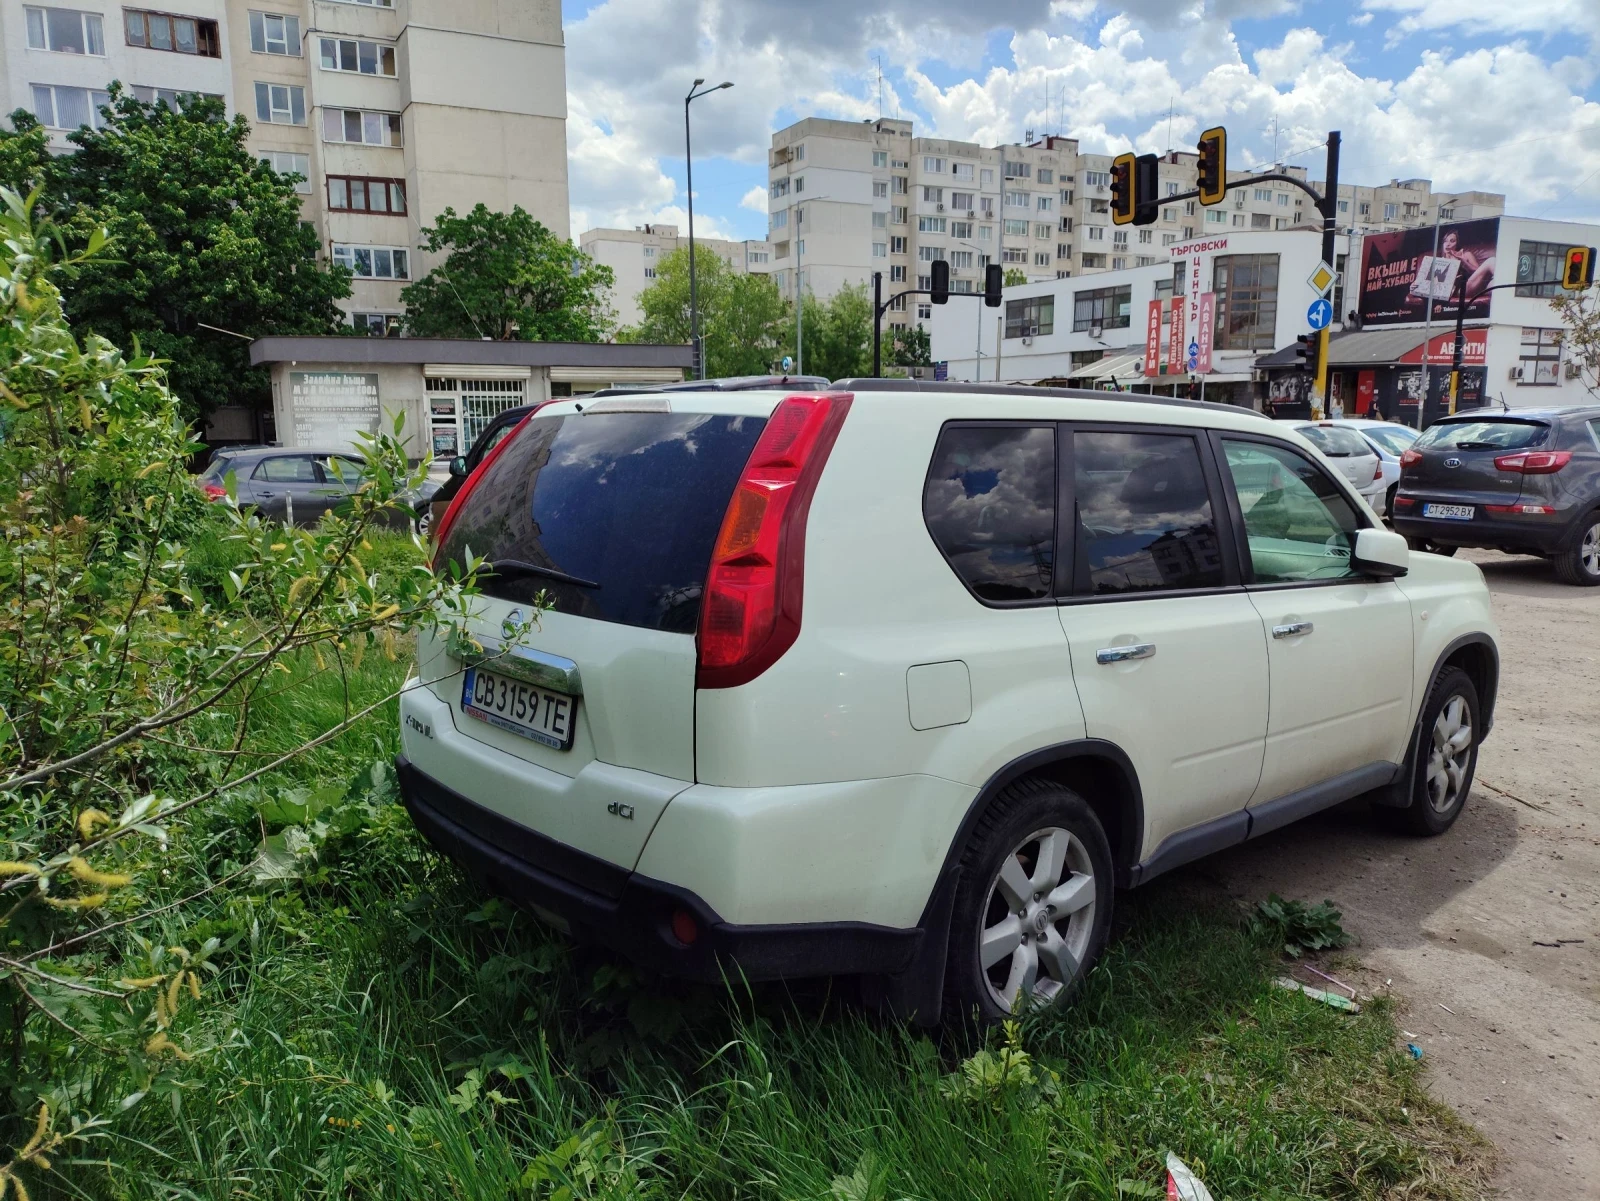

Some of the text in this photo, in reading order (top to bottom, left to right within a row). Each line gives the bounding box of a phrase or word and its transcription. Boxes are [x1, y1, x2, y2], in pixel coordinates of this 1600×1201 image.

[1170, 239, 1227, 256] ТЪРГОВСКИ
[1368, 257, 1417, 280] ВКЪЩИ Е
[1191, 256, 1200, 322] ЦЕНТЪР
[1367, 273, 1416, 292] НАЙ-ХУБАВО
[1149, 308, 1157, 369] АВАНТИ
[1200, 301, 1209, 365] АВАНТИ
[1440, 341, 1485, 355] АВНТИ
[303, 374, 366, 386] Заложна къща
[466, 707, 488, 722] NISSAN
[607, 800, 635, 821] dCi
